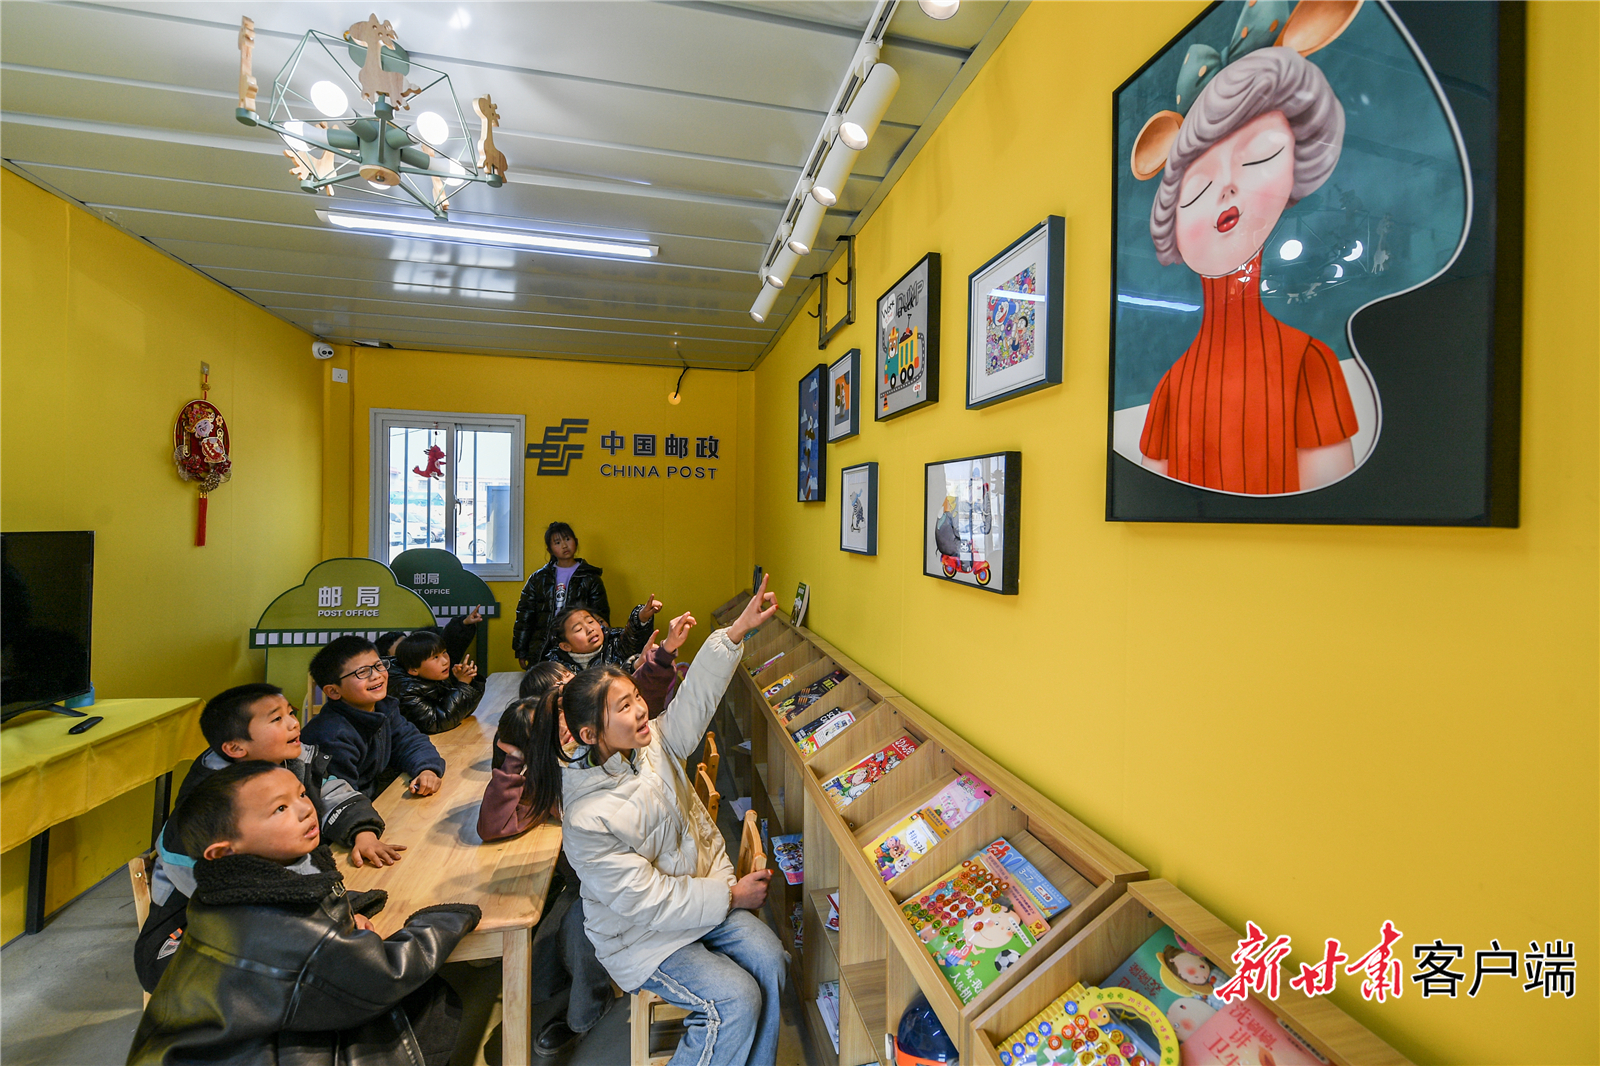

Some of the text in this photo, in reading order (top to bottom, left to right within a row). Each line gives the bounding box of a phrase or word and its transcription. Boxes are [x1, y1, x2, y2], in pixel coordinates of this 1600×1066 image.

[600, 430, 720, 460] 中国邮政
[600, 464, 718, 480] CHINA POST
[413, 572, 440, 585] 邮局
[318, 586, 380, 608] 邮局
[318, 609, 379, 617] POST OFFICE
[949, 972, 975, 1004] 人体机
[1228, 1026, 1252, 1049] 讲
